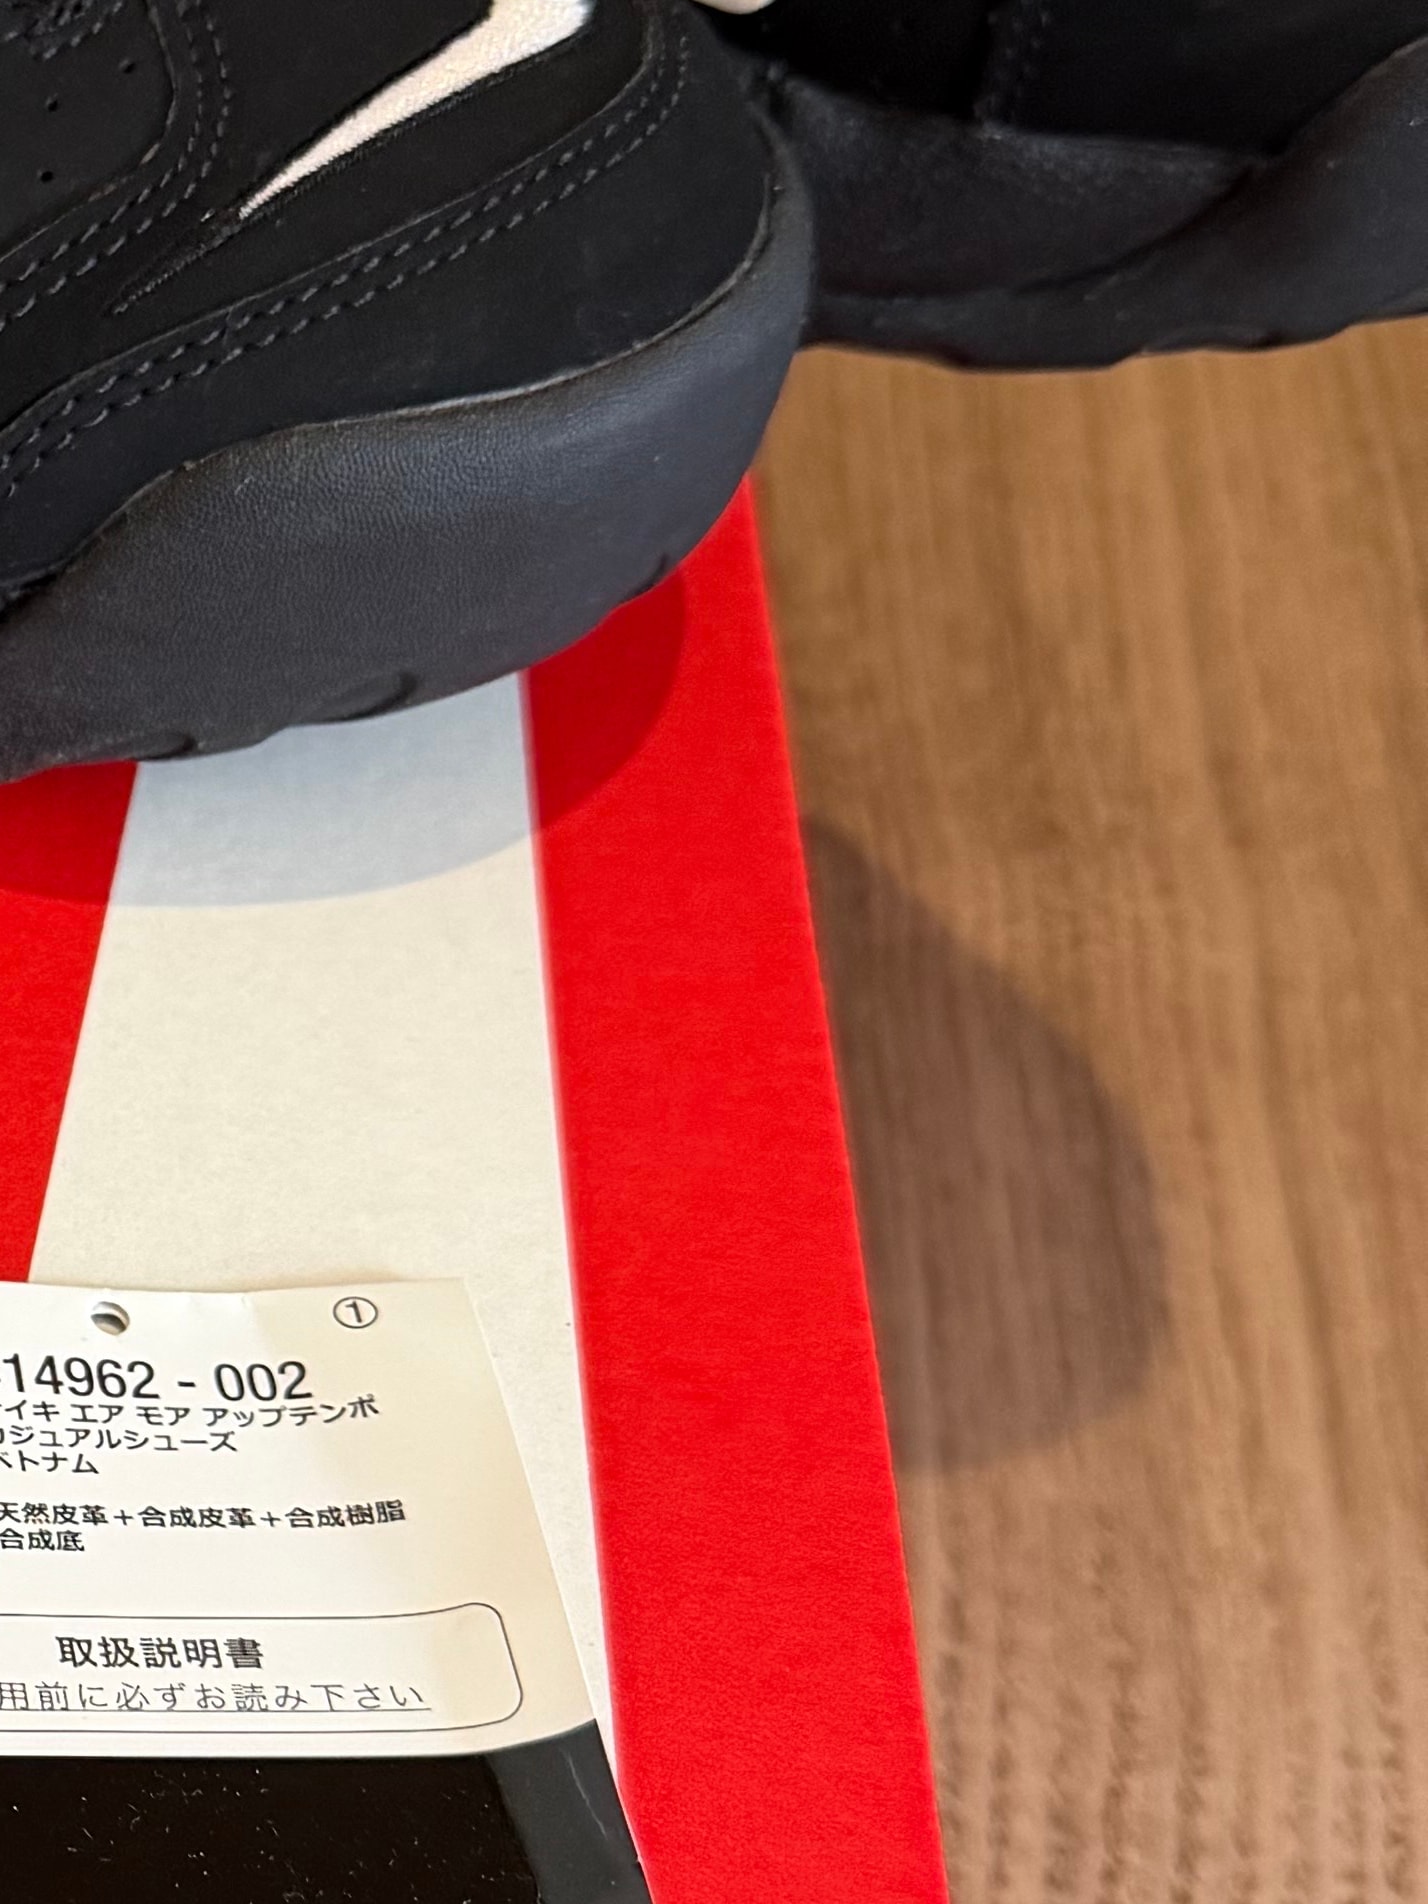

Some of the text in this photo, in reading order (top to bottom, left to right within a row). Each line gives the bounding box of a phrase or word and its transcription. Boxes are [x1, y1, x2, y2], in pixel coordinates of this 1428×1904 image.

[55, 1637, 263, 1669] 取扱説明書
